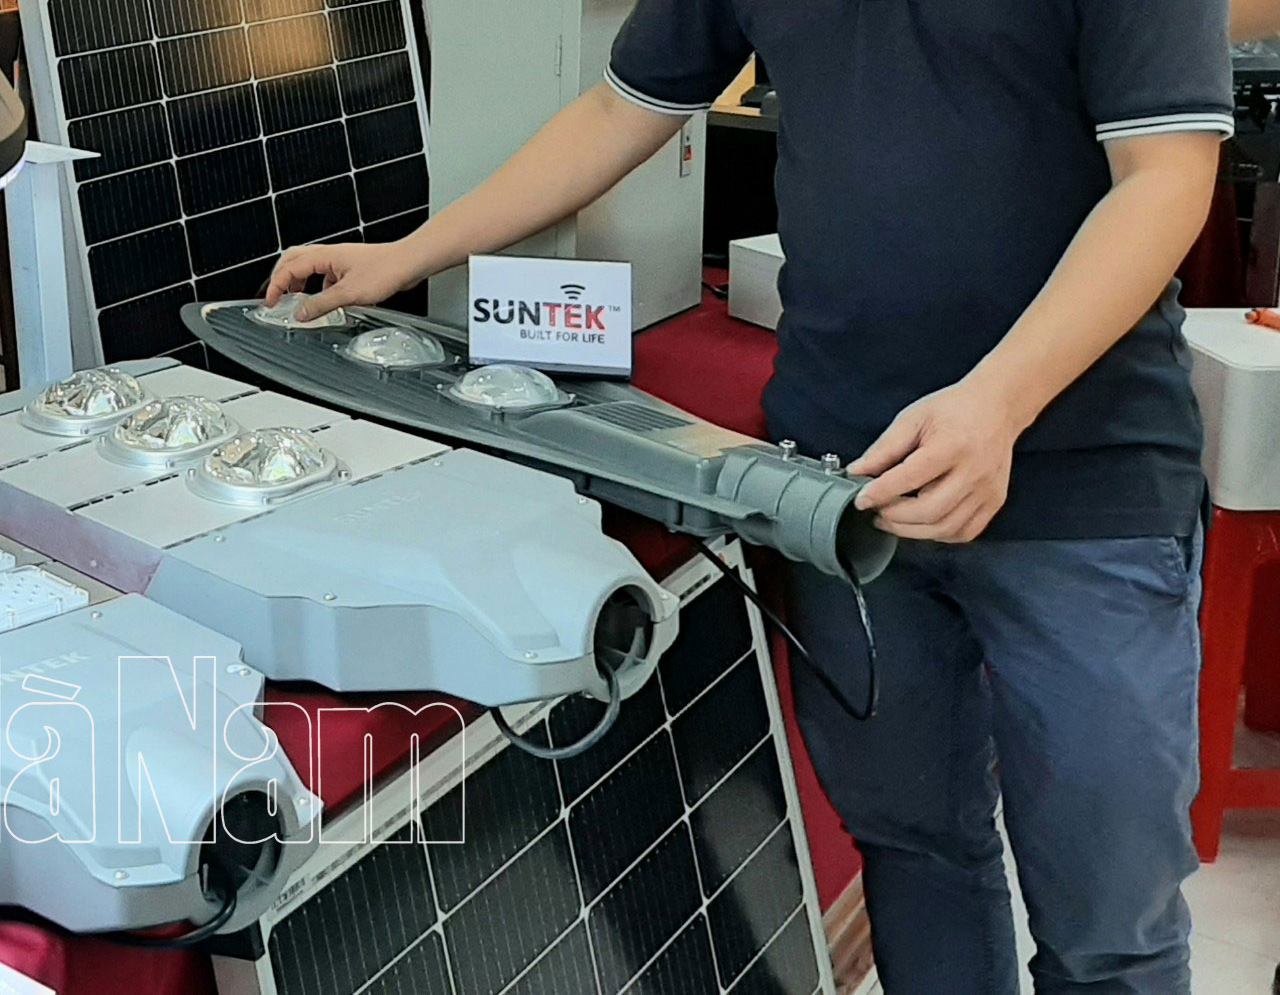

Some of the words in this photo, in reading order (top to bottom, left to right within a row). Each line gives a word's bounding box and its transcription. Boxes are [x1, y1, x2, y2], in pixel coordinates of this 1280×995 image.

[473, 298, 606, 331] SUNTEK
[520, 329, 552, 341] BUILT
[556, 332, 579, 343] FOR
[582, 333, 606, 344] LIFE
